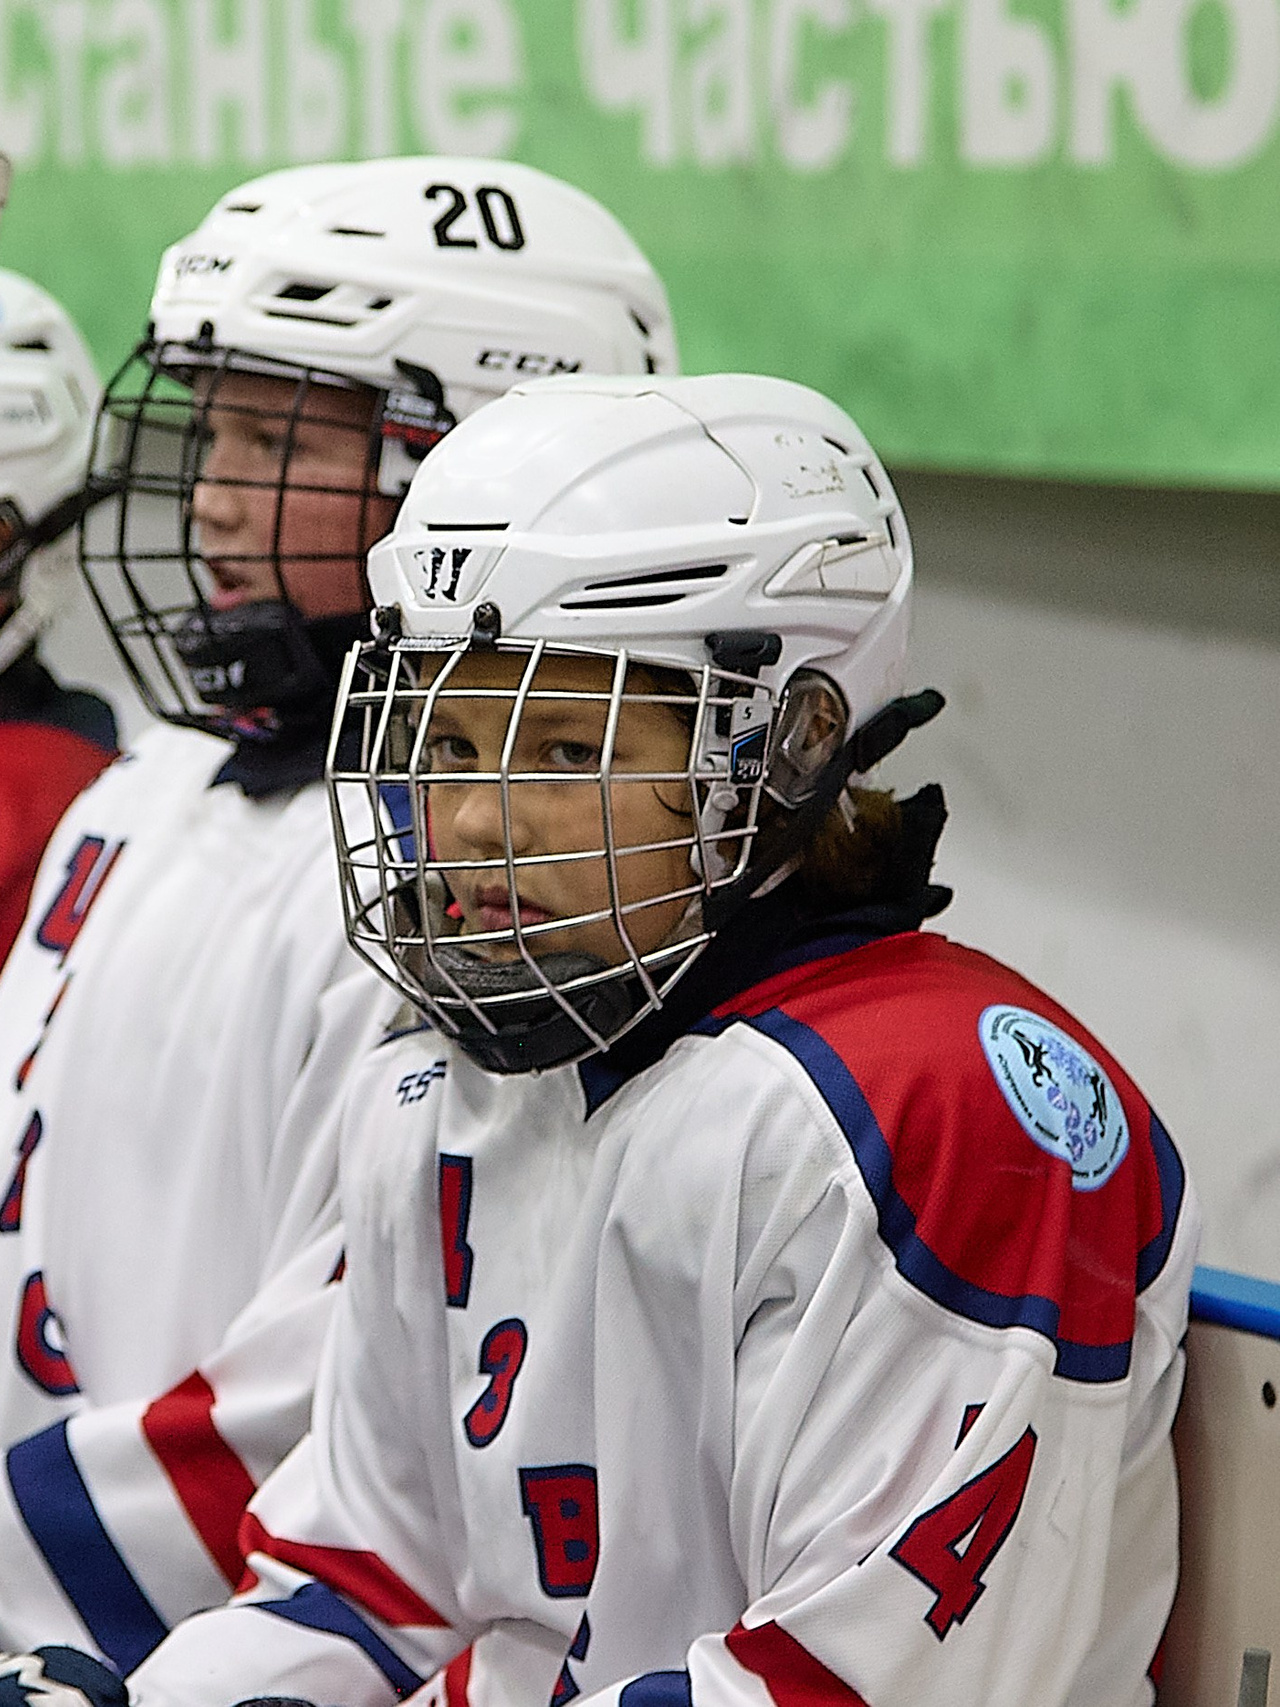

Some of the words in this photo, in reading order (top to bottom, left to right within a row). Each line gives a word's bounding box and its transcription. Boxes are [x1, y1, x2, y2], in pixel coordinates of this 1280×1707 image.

[425, 185, 525, 250] 20
[477, 350, 583, 376] CCM
[856, 1401, 1038, 1642] 4
